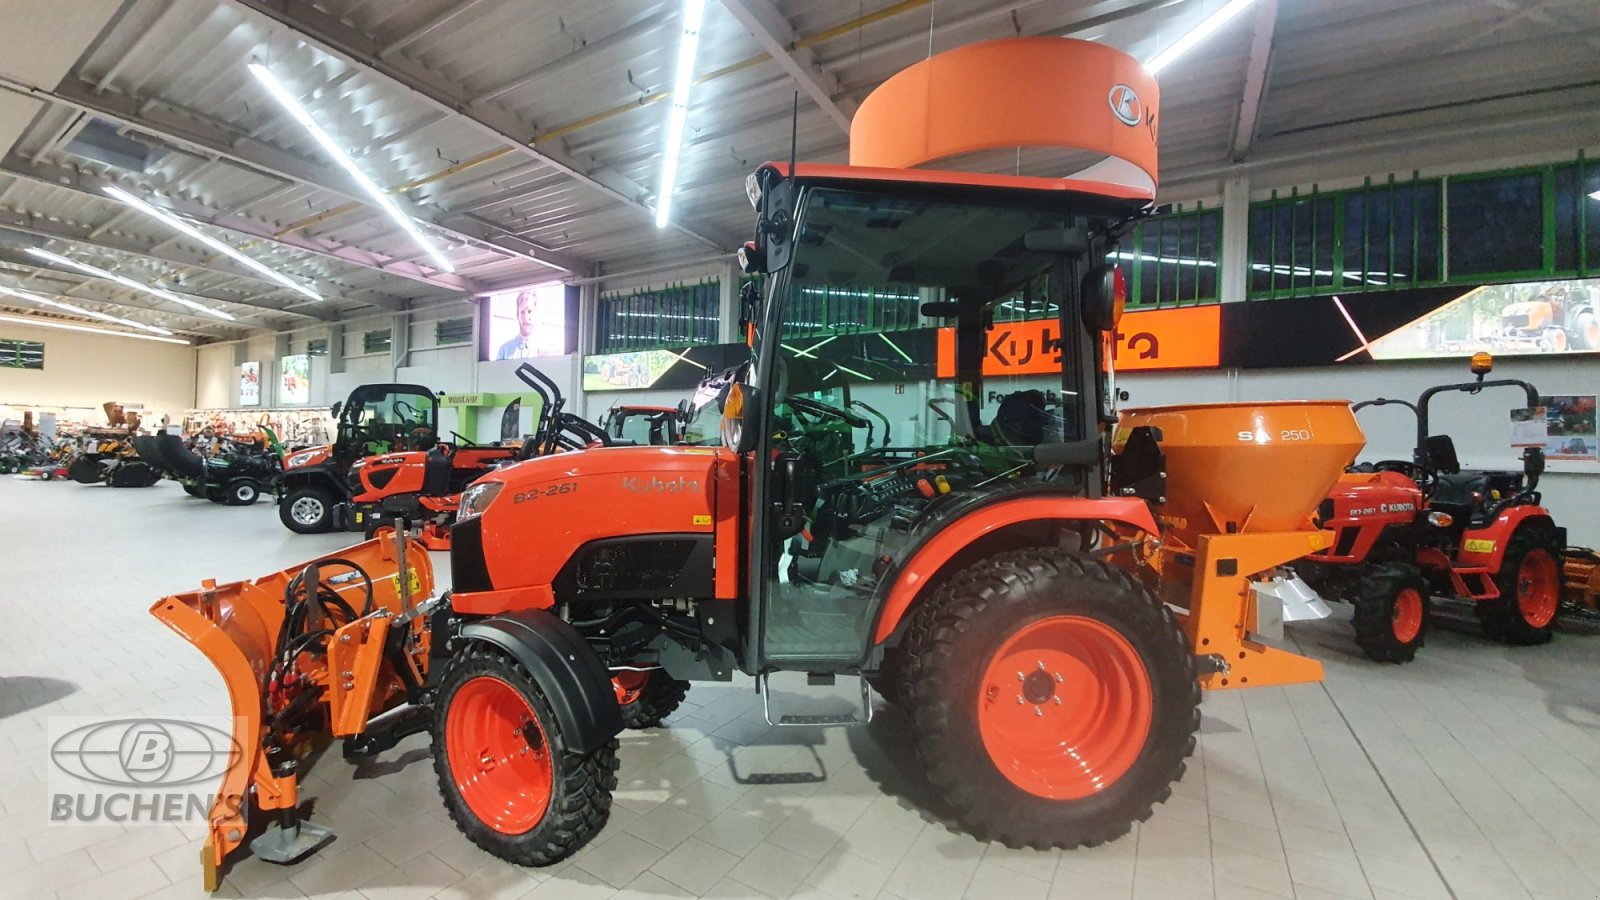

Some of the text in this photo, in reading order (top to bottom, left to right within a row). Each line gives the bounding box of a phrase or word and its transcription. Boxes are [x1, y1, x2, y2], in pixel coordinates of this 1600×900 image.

[1281, 430, 1310, 441] 250
[623, 476, 700, 494] Kubota
[513, 483, 577, 504] B2-261
[1389, 503, 1415, 512] KUBOTA
